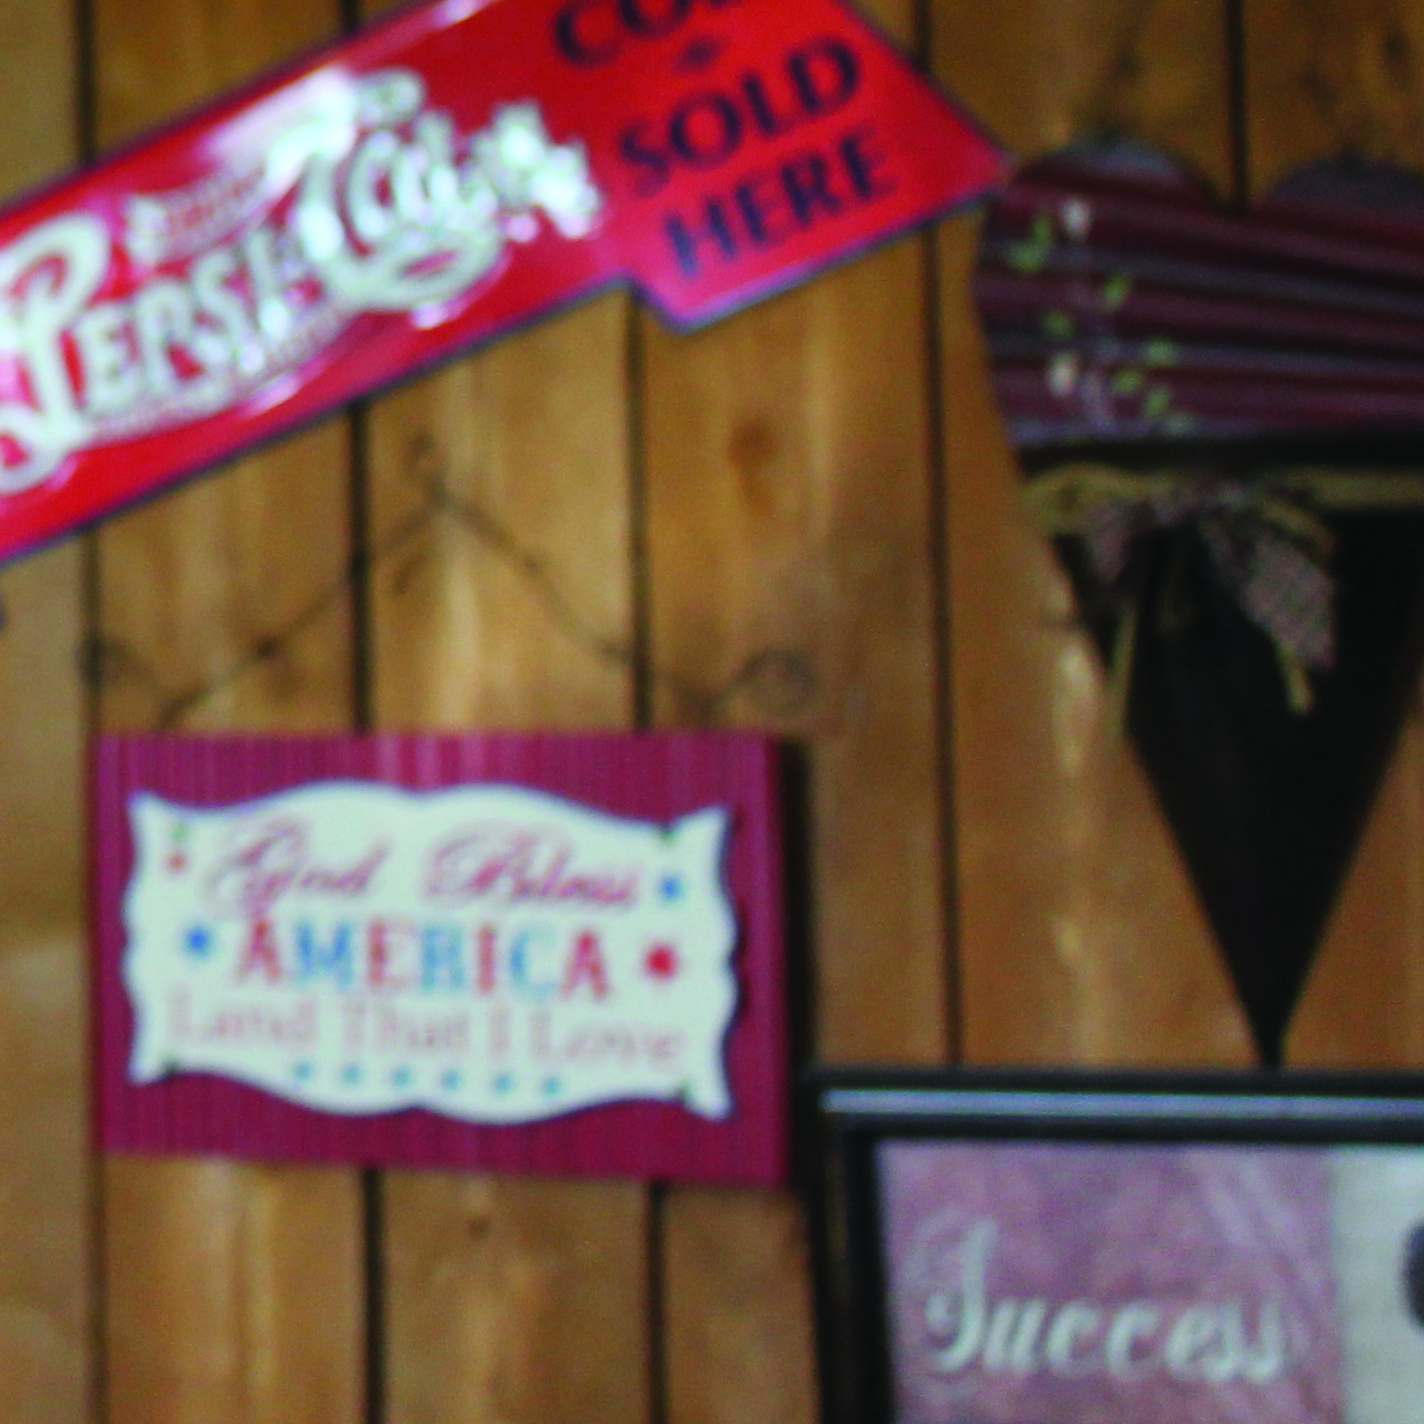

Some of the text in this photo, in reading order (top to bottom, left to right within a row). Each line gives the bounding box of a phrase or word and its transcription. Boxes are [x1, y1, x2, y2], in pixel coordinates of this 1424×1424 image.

[618, 36, 862, 198] SOLD
[664, 126, 894, 276] HERE
[166, 990, 684, 1062] Land That I Love
[238, 918, 612, 1002] AMERICA
[905, 1208, 1288, 1384] Success
